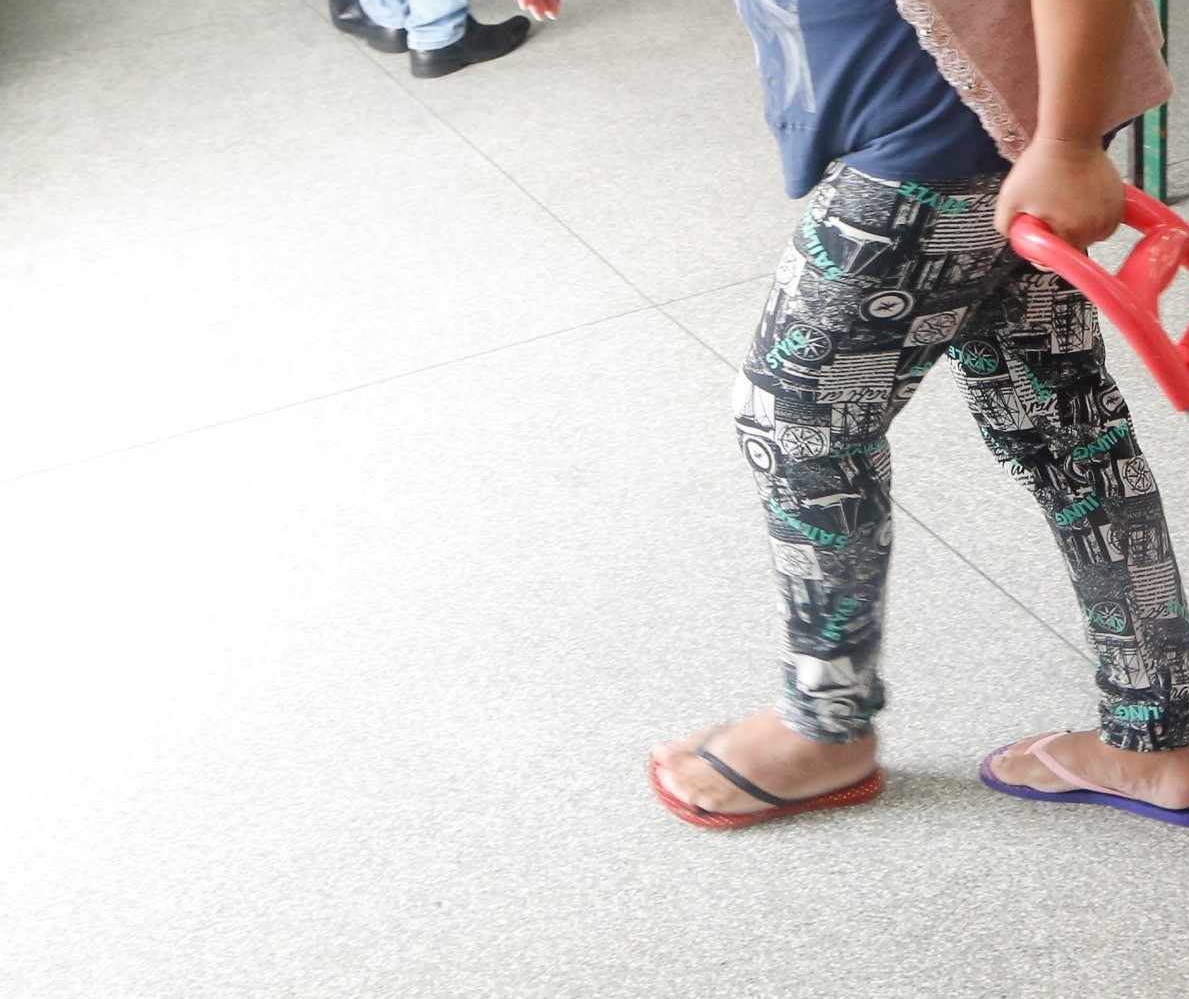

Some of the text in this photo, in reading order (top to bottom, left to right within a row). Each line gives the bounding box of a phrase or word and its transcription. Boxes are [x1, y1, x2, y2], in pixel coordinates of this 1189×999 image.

[765, 329, 809, 370] STYLE
[1073, 421, 1130, 461] SAILING
[1113, 704, 1164, 722] LING
